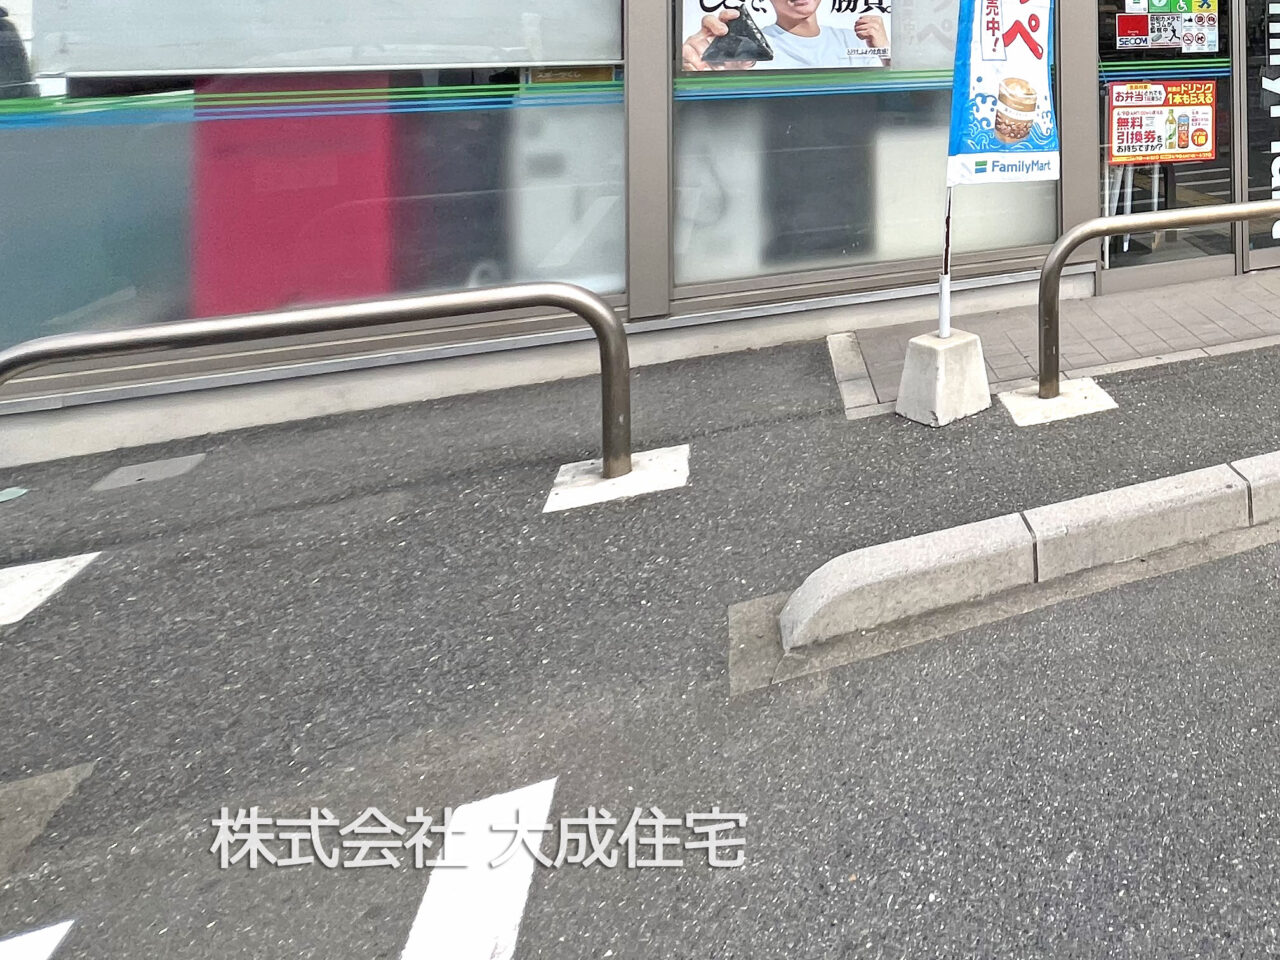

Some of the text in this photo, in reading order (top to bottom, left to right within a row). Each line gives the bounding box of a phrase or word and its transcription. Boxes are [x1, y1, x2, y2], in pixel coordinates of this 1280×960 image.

[1119, 37, 1148, 46] SECOM
[1115, 90, 1143, 102] お弁当
[1167, 93, 1214, 105] 1本もらえる
[1117, 116, 1143, 130] 無料
[1117, 130, 1162, 144] 引換券を
[1117, 143, 1163, 153] お持ちですか?
[991, 159, 1052, 174] FamilyMart
